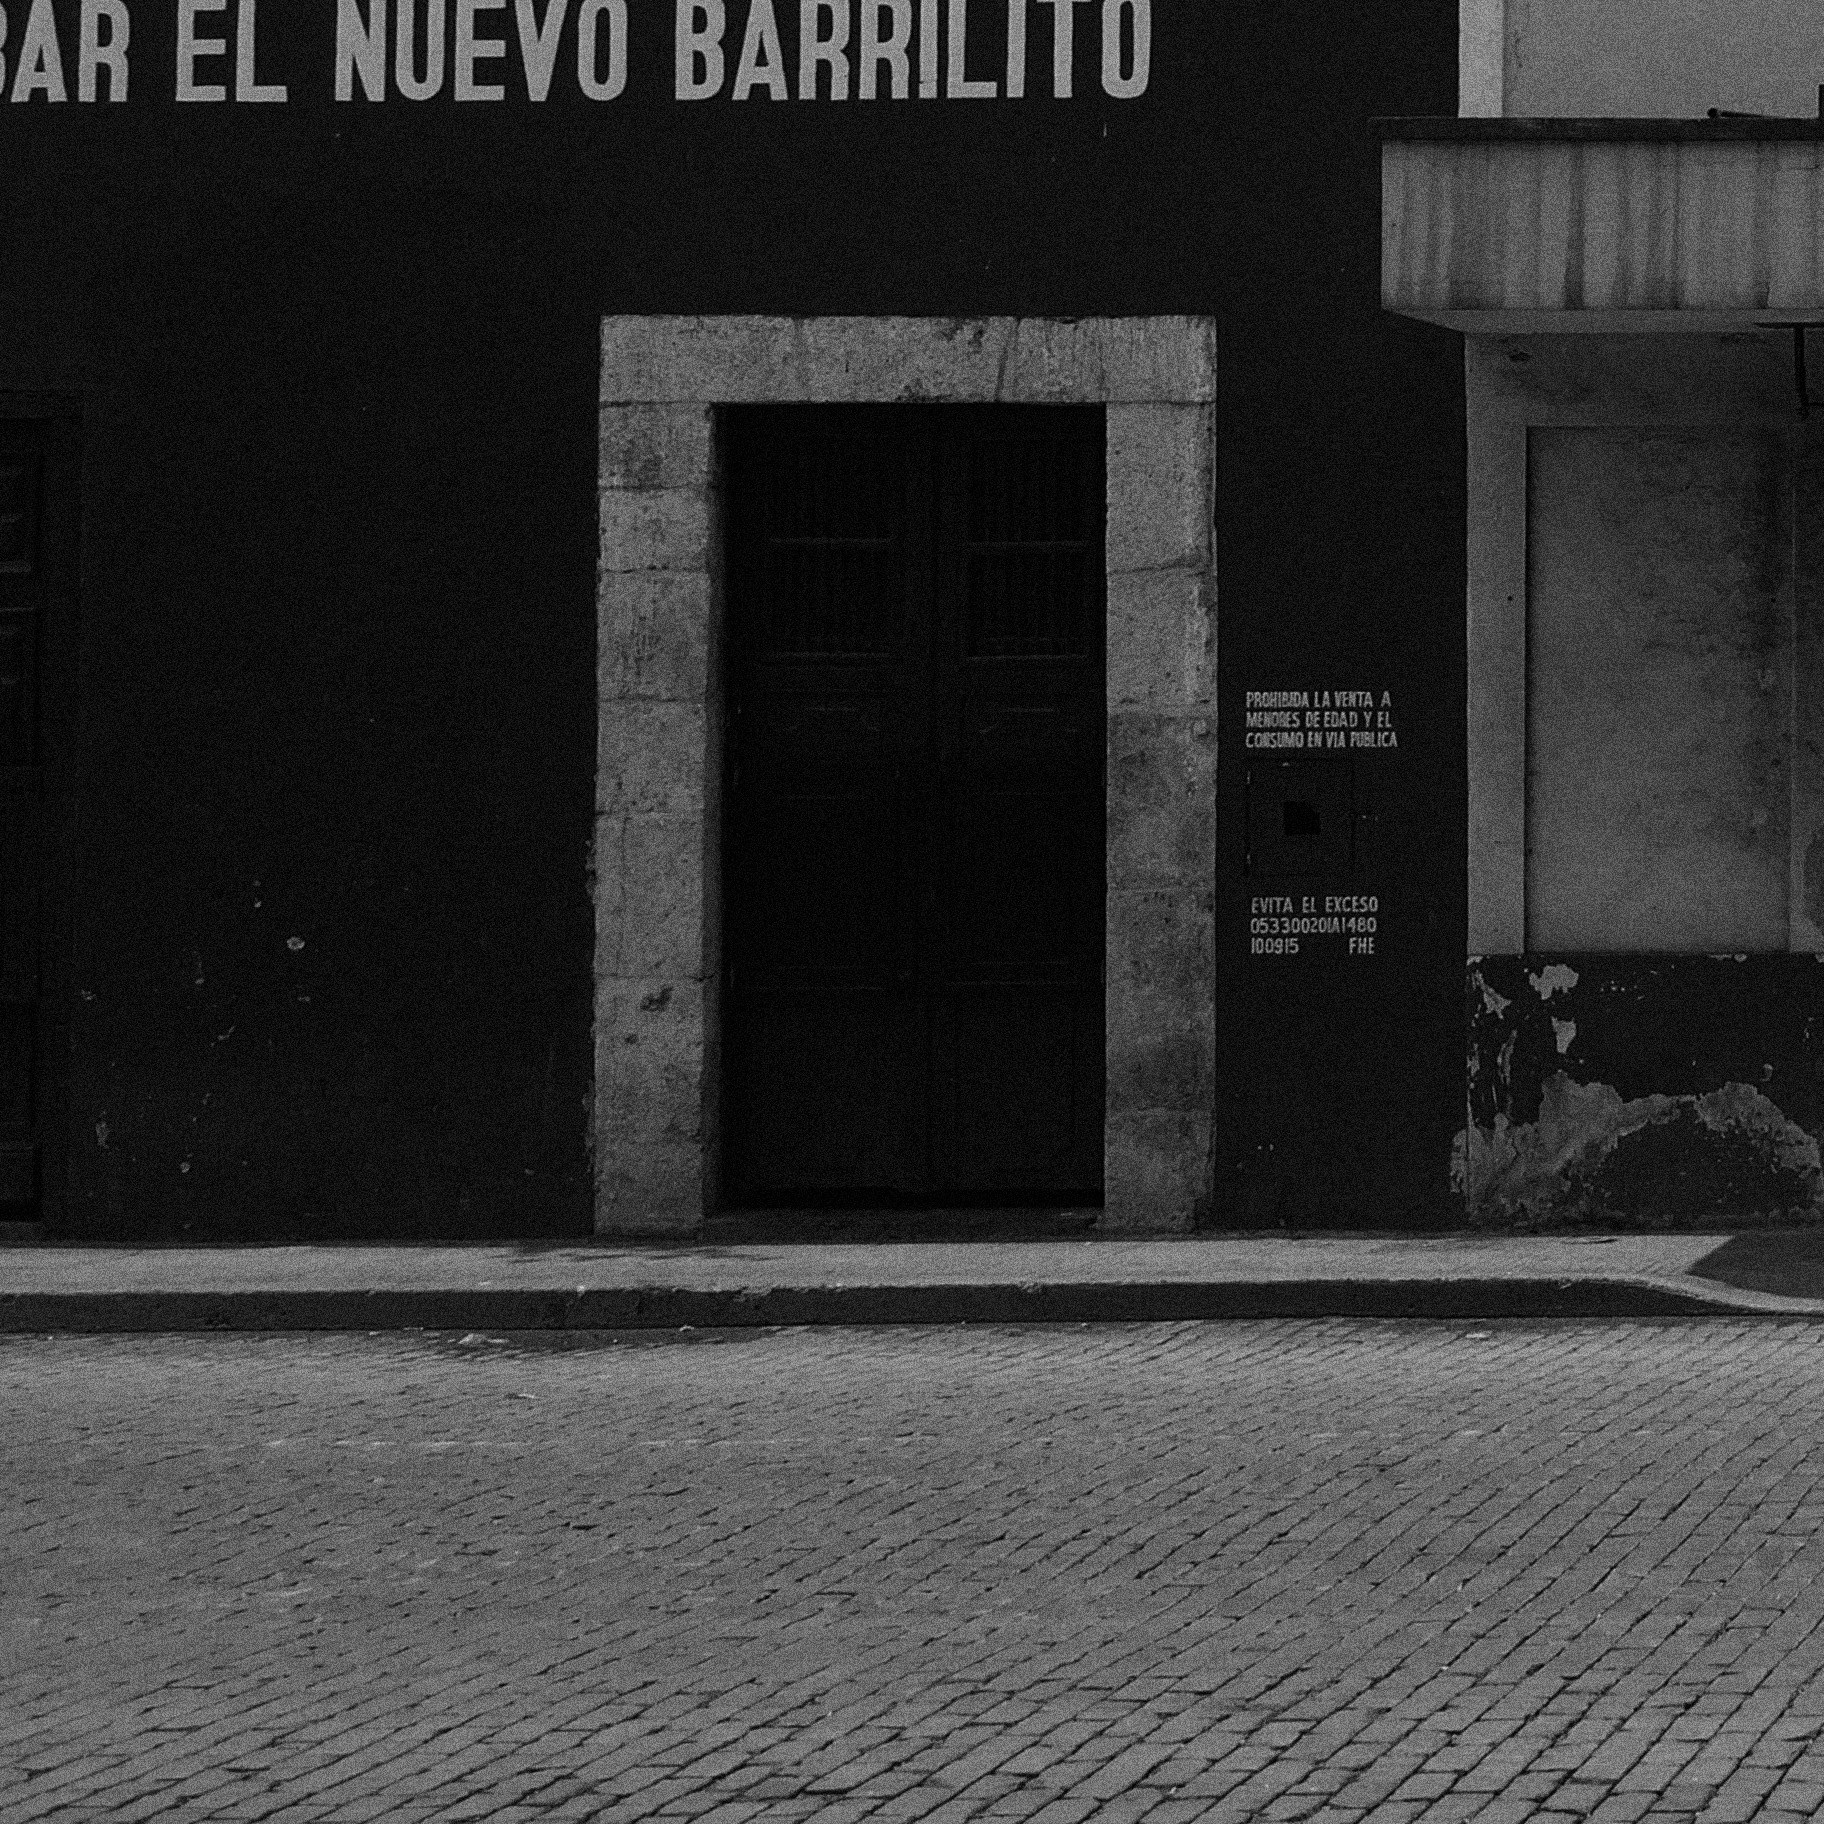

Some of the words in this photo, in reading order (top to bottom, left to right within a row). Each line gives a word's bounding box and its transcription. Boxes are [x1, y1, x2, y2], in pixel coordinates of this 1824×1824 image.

[1246, 691, 1310, 708] PROHIBIDA
[1314, 691, 1331, 708] LA
[1334, 691, 1373, 708] VENTA
[1381, 691, 1391, 707] A
[1246, 711, 1300, 728] MENORES
[1305, 711, 1320, 728] DE
[1324, 711, 1358, 728] EDAD
[1363, 711, 1372, 727] Y
[1377, 711, 1392, 728] EL
[1246, 731, 1304, 748] CONSUMO
[1307, 732, 1322, 748] EN
[1325, 732, 1346, 748] VIA
[1350, 731, 1398, 748] PUBLICA
[1251, 896, 1293, 913] EVITA
[1302, 896, 1317, 913] EL
[1325, 896, 1379, 913] EXCESO
